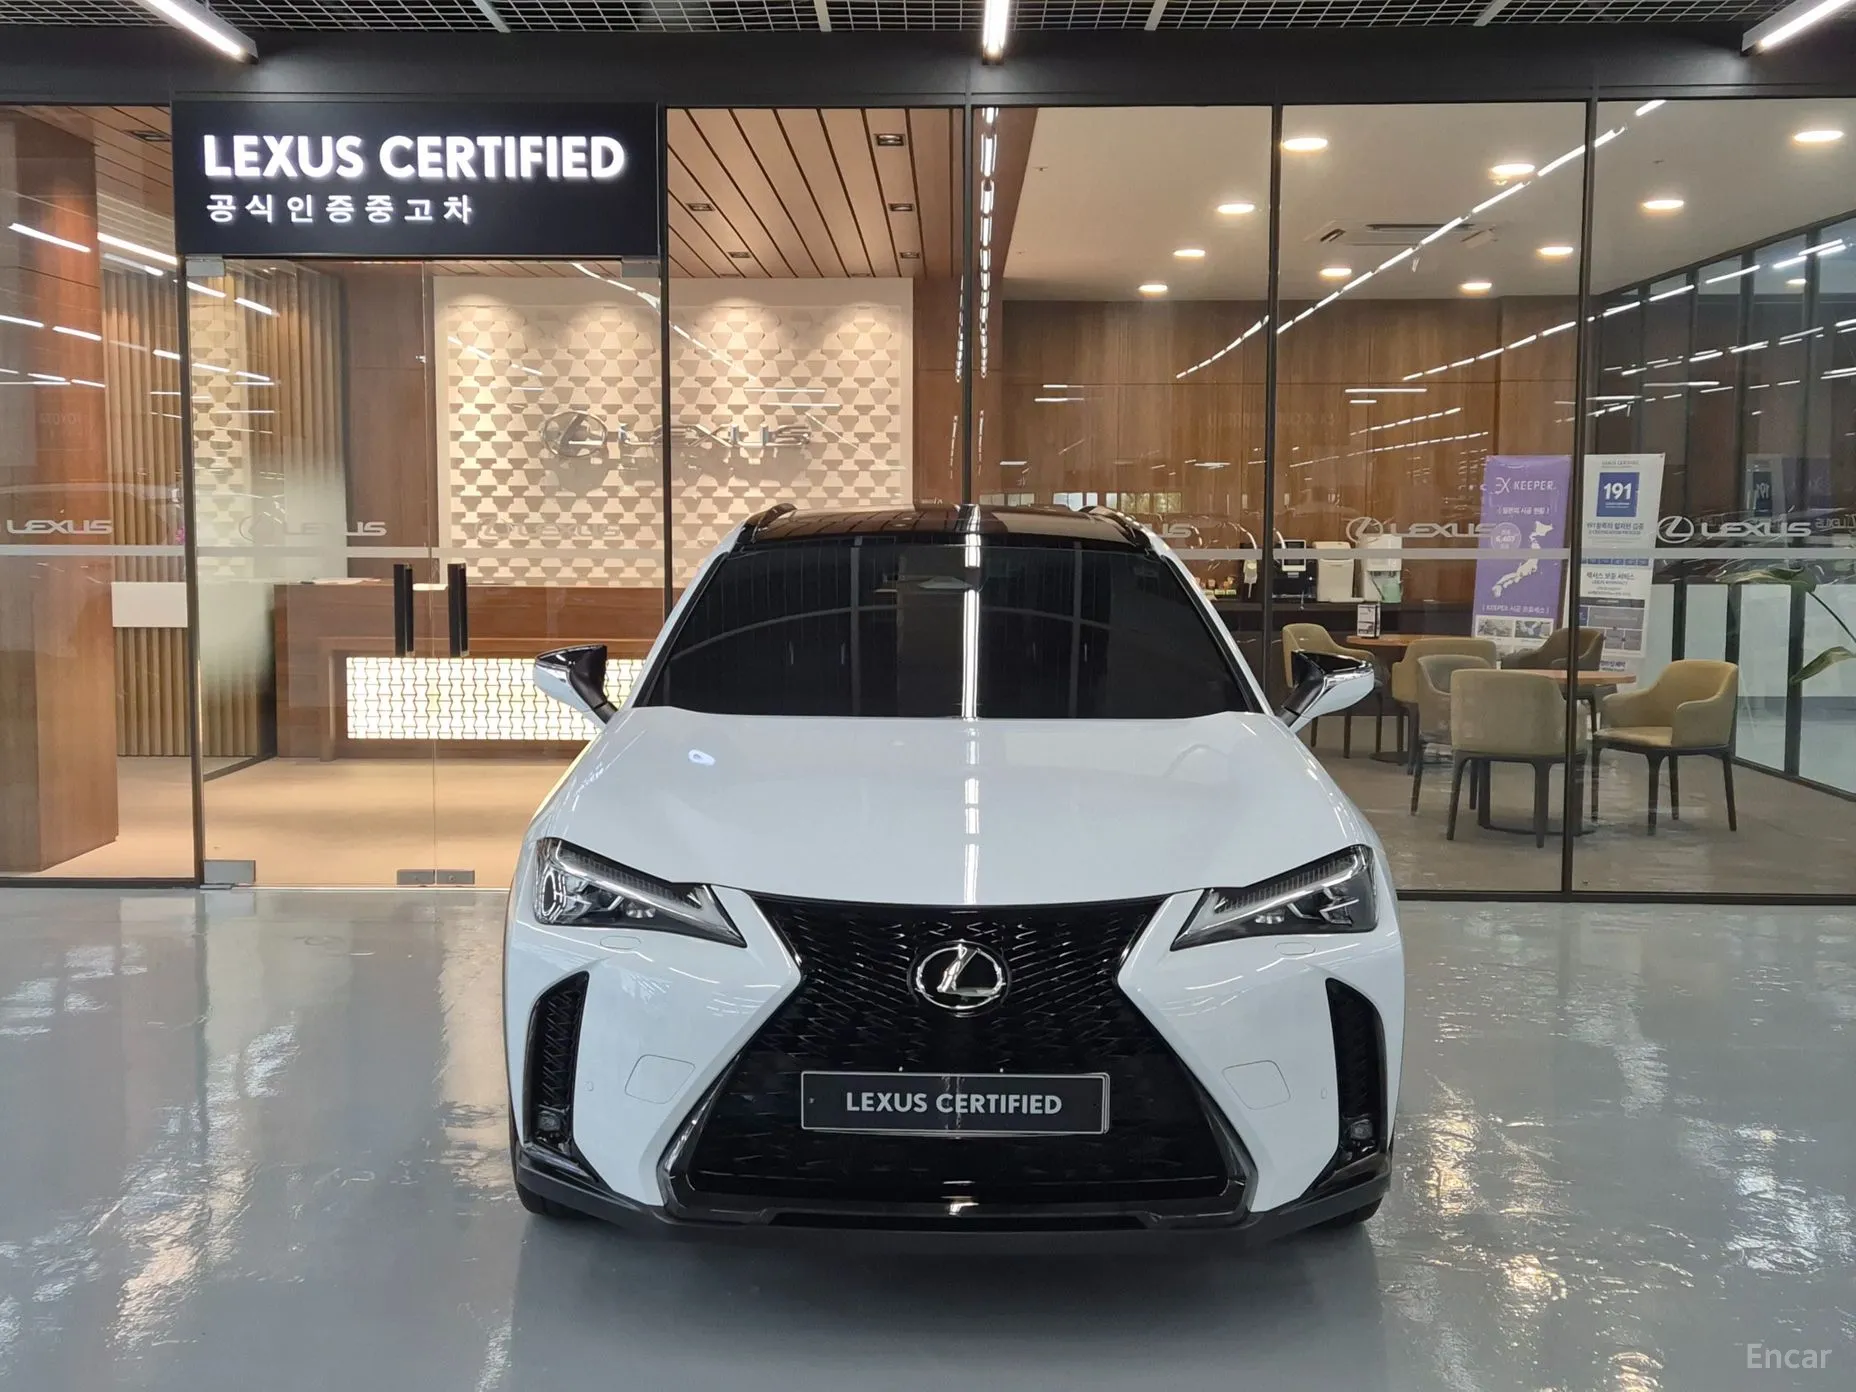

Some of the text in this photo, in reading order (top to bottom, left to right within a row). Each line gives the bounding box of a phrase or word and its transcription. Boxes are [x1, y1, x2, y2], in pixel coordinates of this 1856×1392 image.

[203, 134, 625, 179] LEXUS CERTIFIED
[618, 422, 812, 448] LEXUS
[1513, 480, 1554, 491] KEEPER
[1603, 482, 1632, 500] 191
[6, 519, 113, 534] LEXUS
[284, 521, 387, 536] LEUS
[1390, 522, 1499, 538] LEXUS
[1701, 521, 1812, 538] LEXUS
[846, 1091, 1063, 1115] LEXUS CERTIFIED
